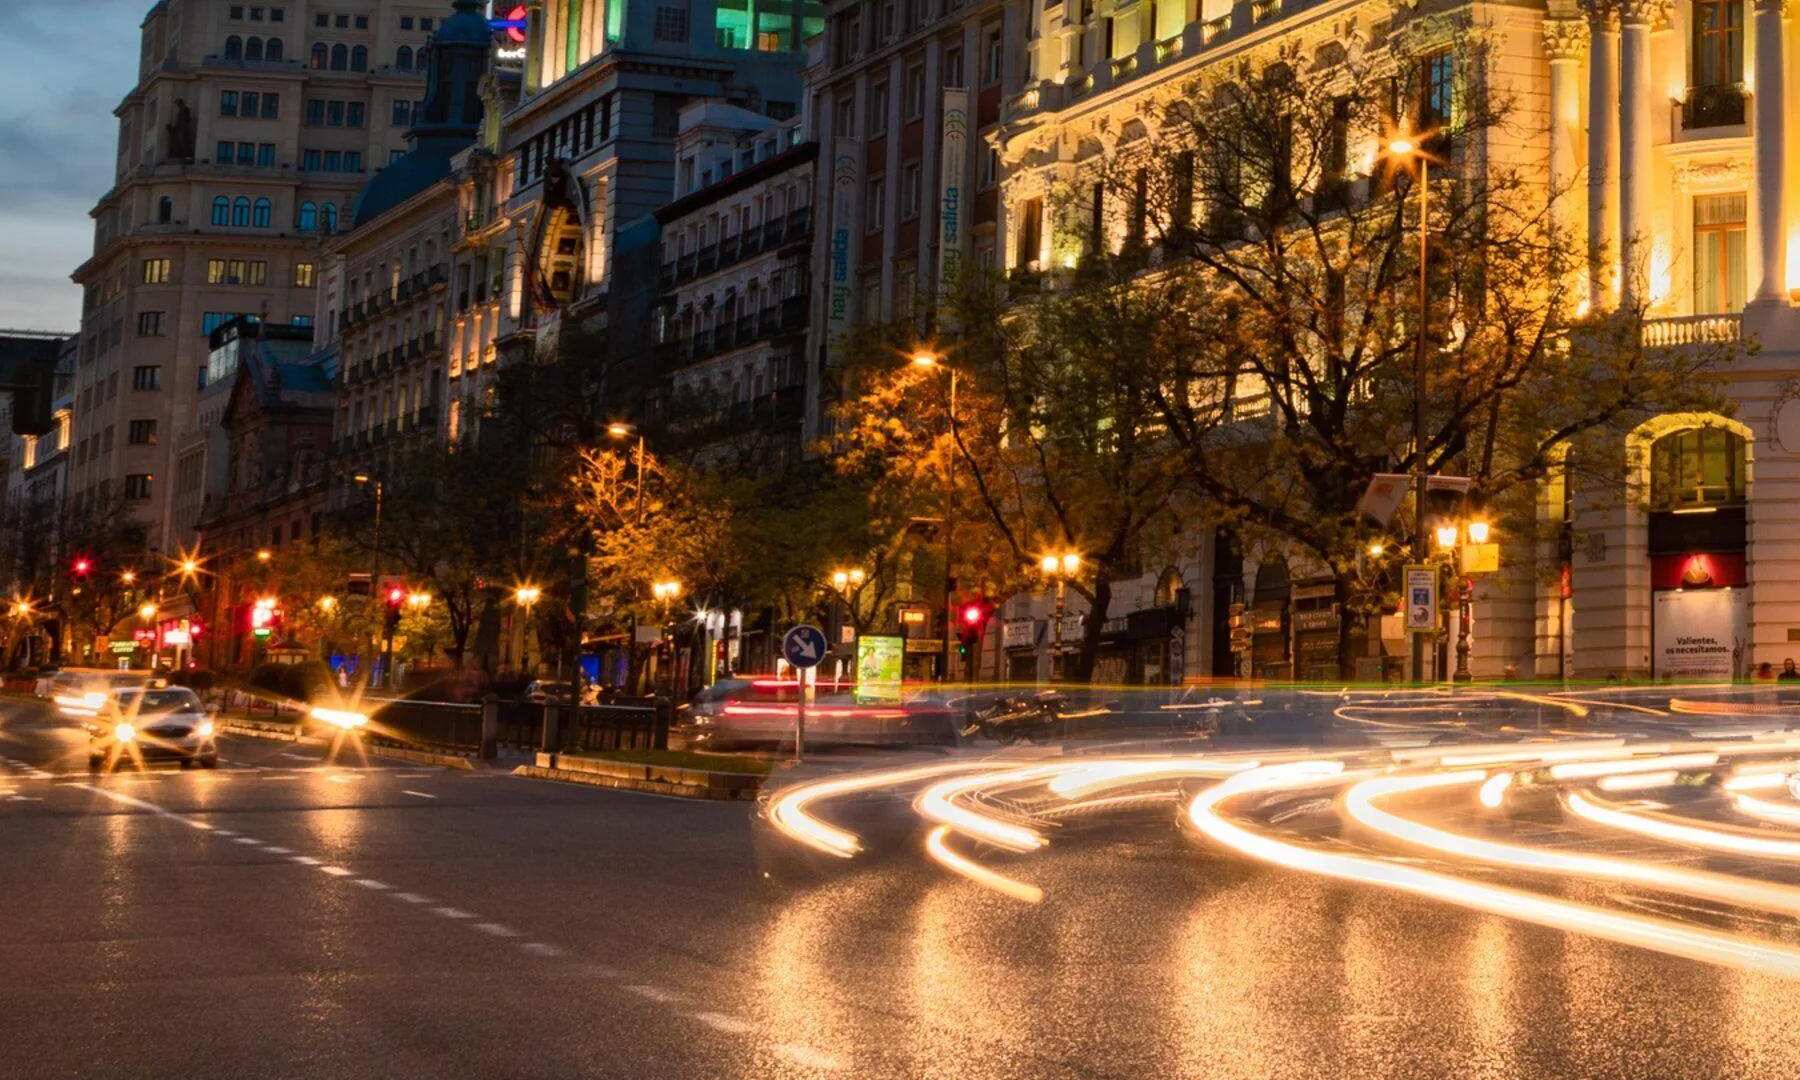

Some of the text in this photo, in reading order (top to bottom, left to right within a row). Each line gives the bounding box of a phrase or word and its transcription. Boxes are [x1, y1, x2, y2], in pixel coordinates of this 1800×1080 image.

[940, 186, 959, 243] salida
[831, 228, 849, 282] salida
[830, 286, 851, 320] hay
[1053, 621, 1079, 633] OTLET
[1675, 646, 1730, 654] necesitamos.
[1676, 637, 1718, 646] Valientes,
